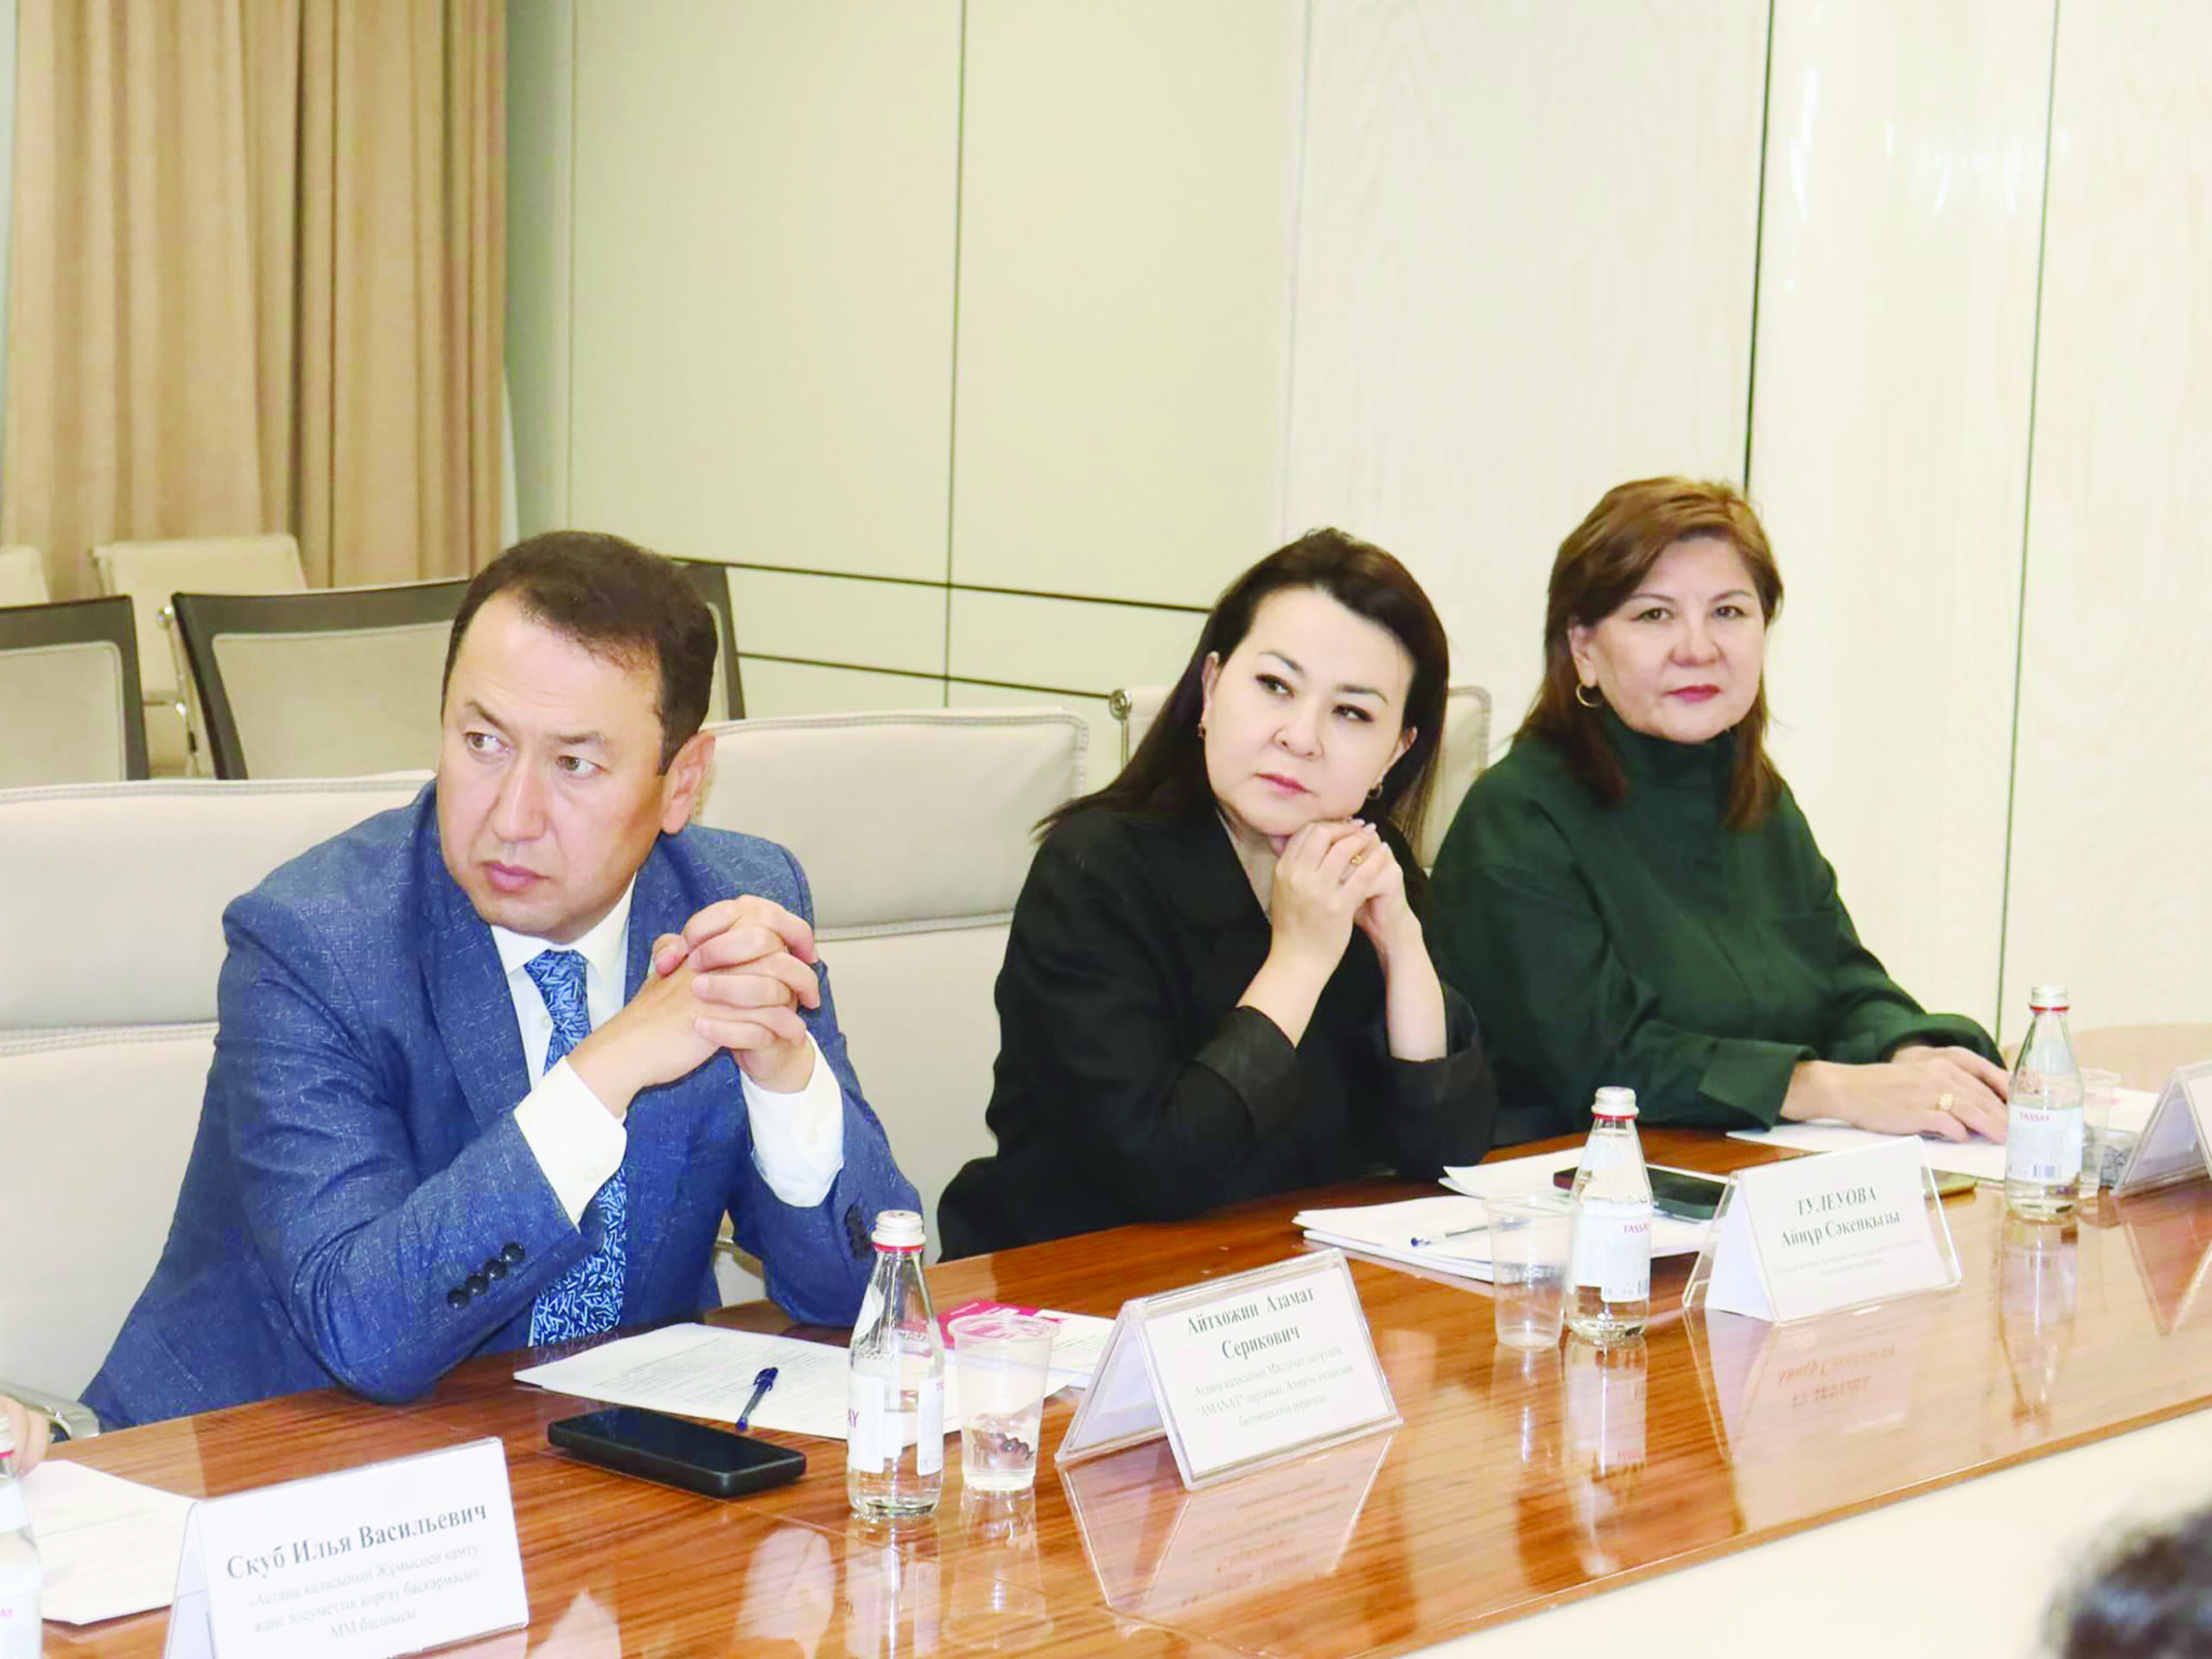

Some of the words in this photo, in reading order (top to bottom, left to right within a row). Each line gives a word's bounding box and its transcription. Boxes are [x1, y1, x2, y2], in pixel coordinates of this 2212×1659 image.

[1796, 1185, 1878, 1217] ТУЛЕУОВА
[1187, 1303, 1260, 1336] Айтхожин
[1267, 1287, 1315, 1313] Азамат
[1221, 1325, 1300, 1360] Серикович
[226, 1546, 285, 1580] Скуб
[292, 1535, 352, 1565] Илья
[359, 1503, 487, 1549] Васильевич
